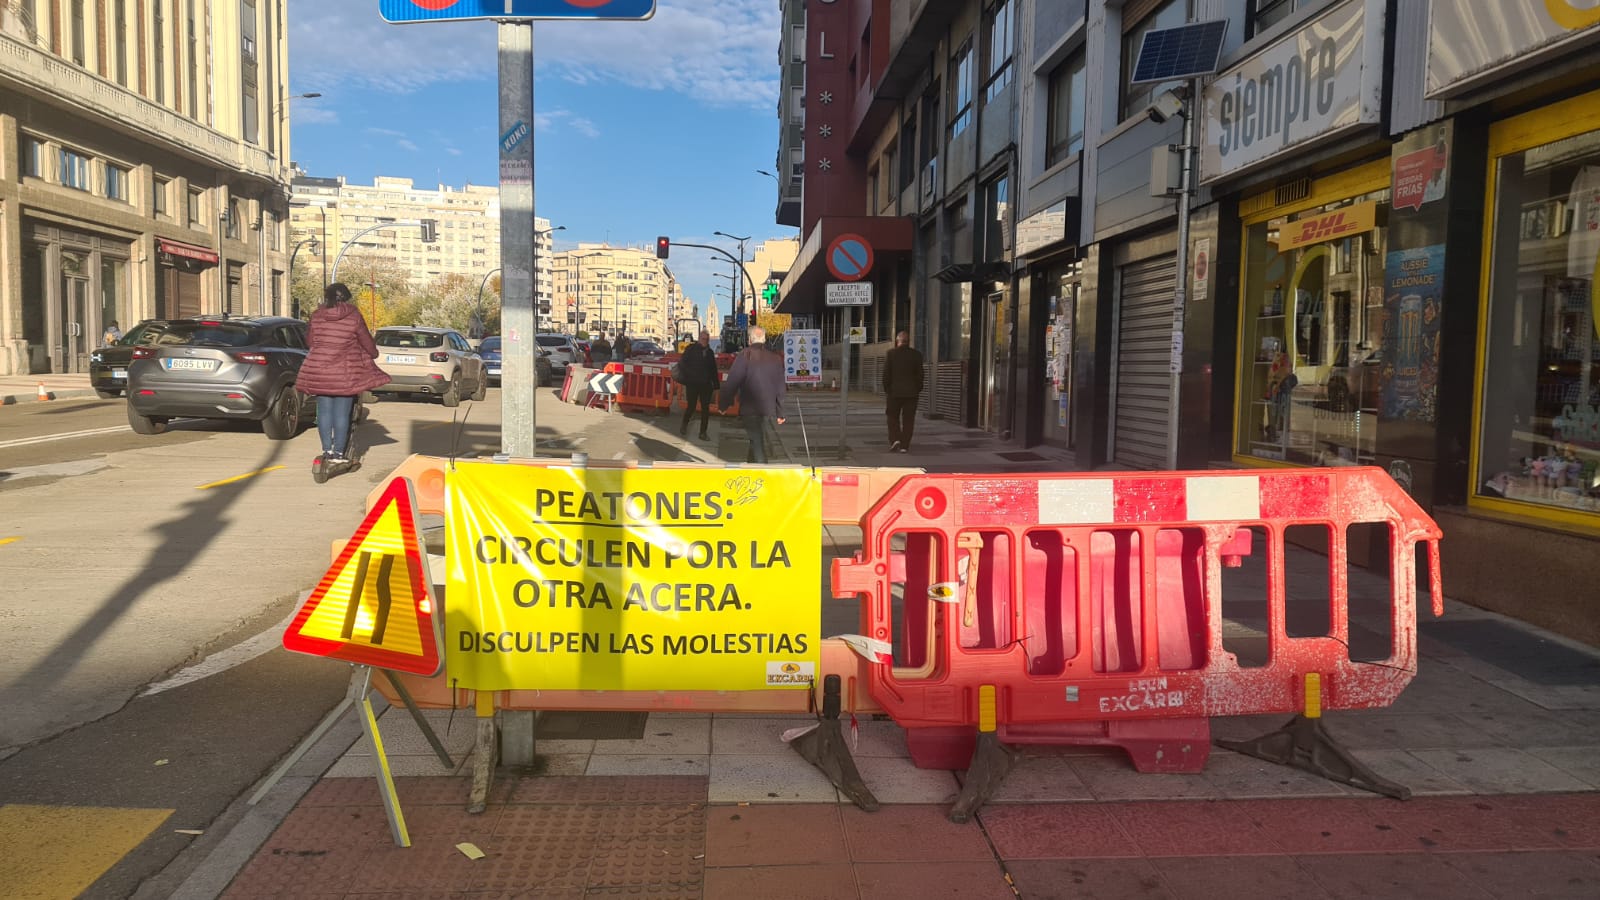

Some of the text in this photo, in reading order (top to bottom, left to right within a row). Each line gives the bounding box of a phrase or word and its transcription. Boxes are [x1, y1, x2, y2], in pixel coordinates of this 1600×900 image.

[1219, 36, 1336, 157] siempre
[1302, 212, 1346, 242] DHL
[1401, 257, 1429, 271] AUSSIE
[1392, 274, 1436, 288] LEMONADE
[173, 360, 194, 368] 6095
[535, 488, 733, 520] PEATONES:
[476, 535, 792, 569] CIRCULEN POR LA
[513, 579, 752, 612] OTRA ACERA.
[459, 630, 808, 656] DISCULPEN LAS MOLESTIAS
